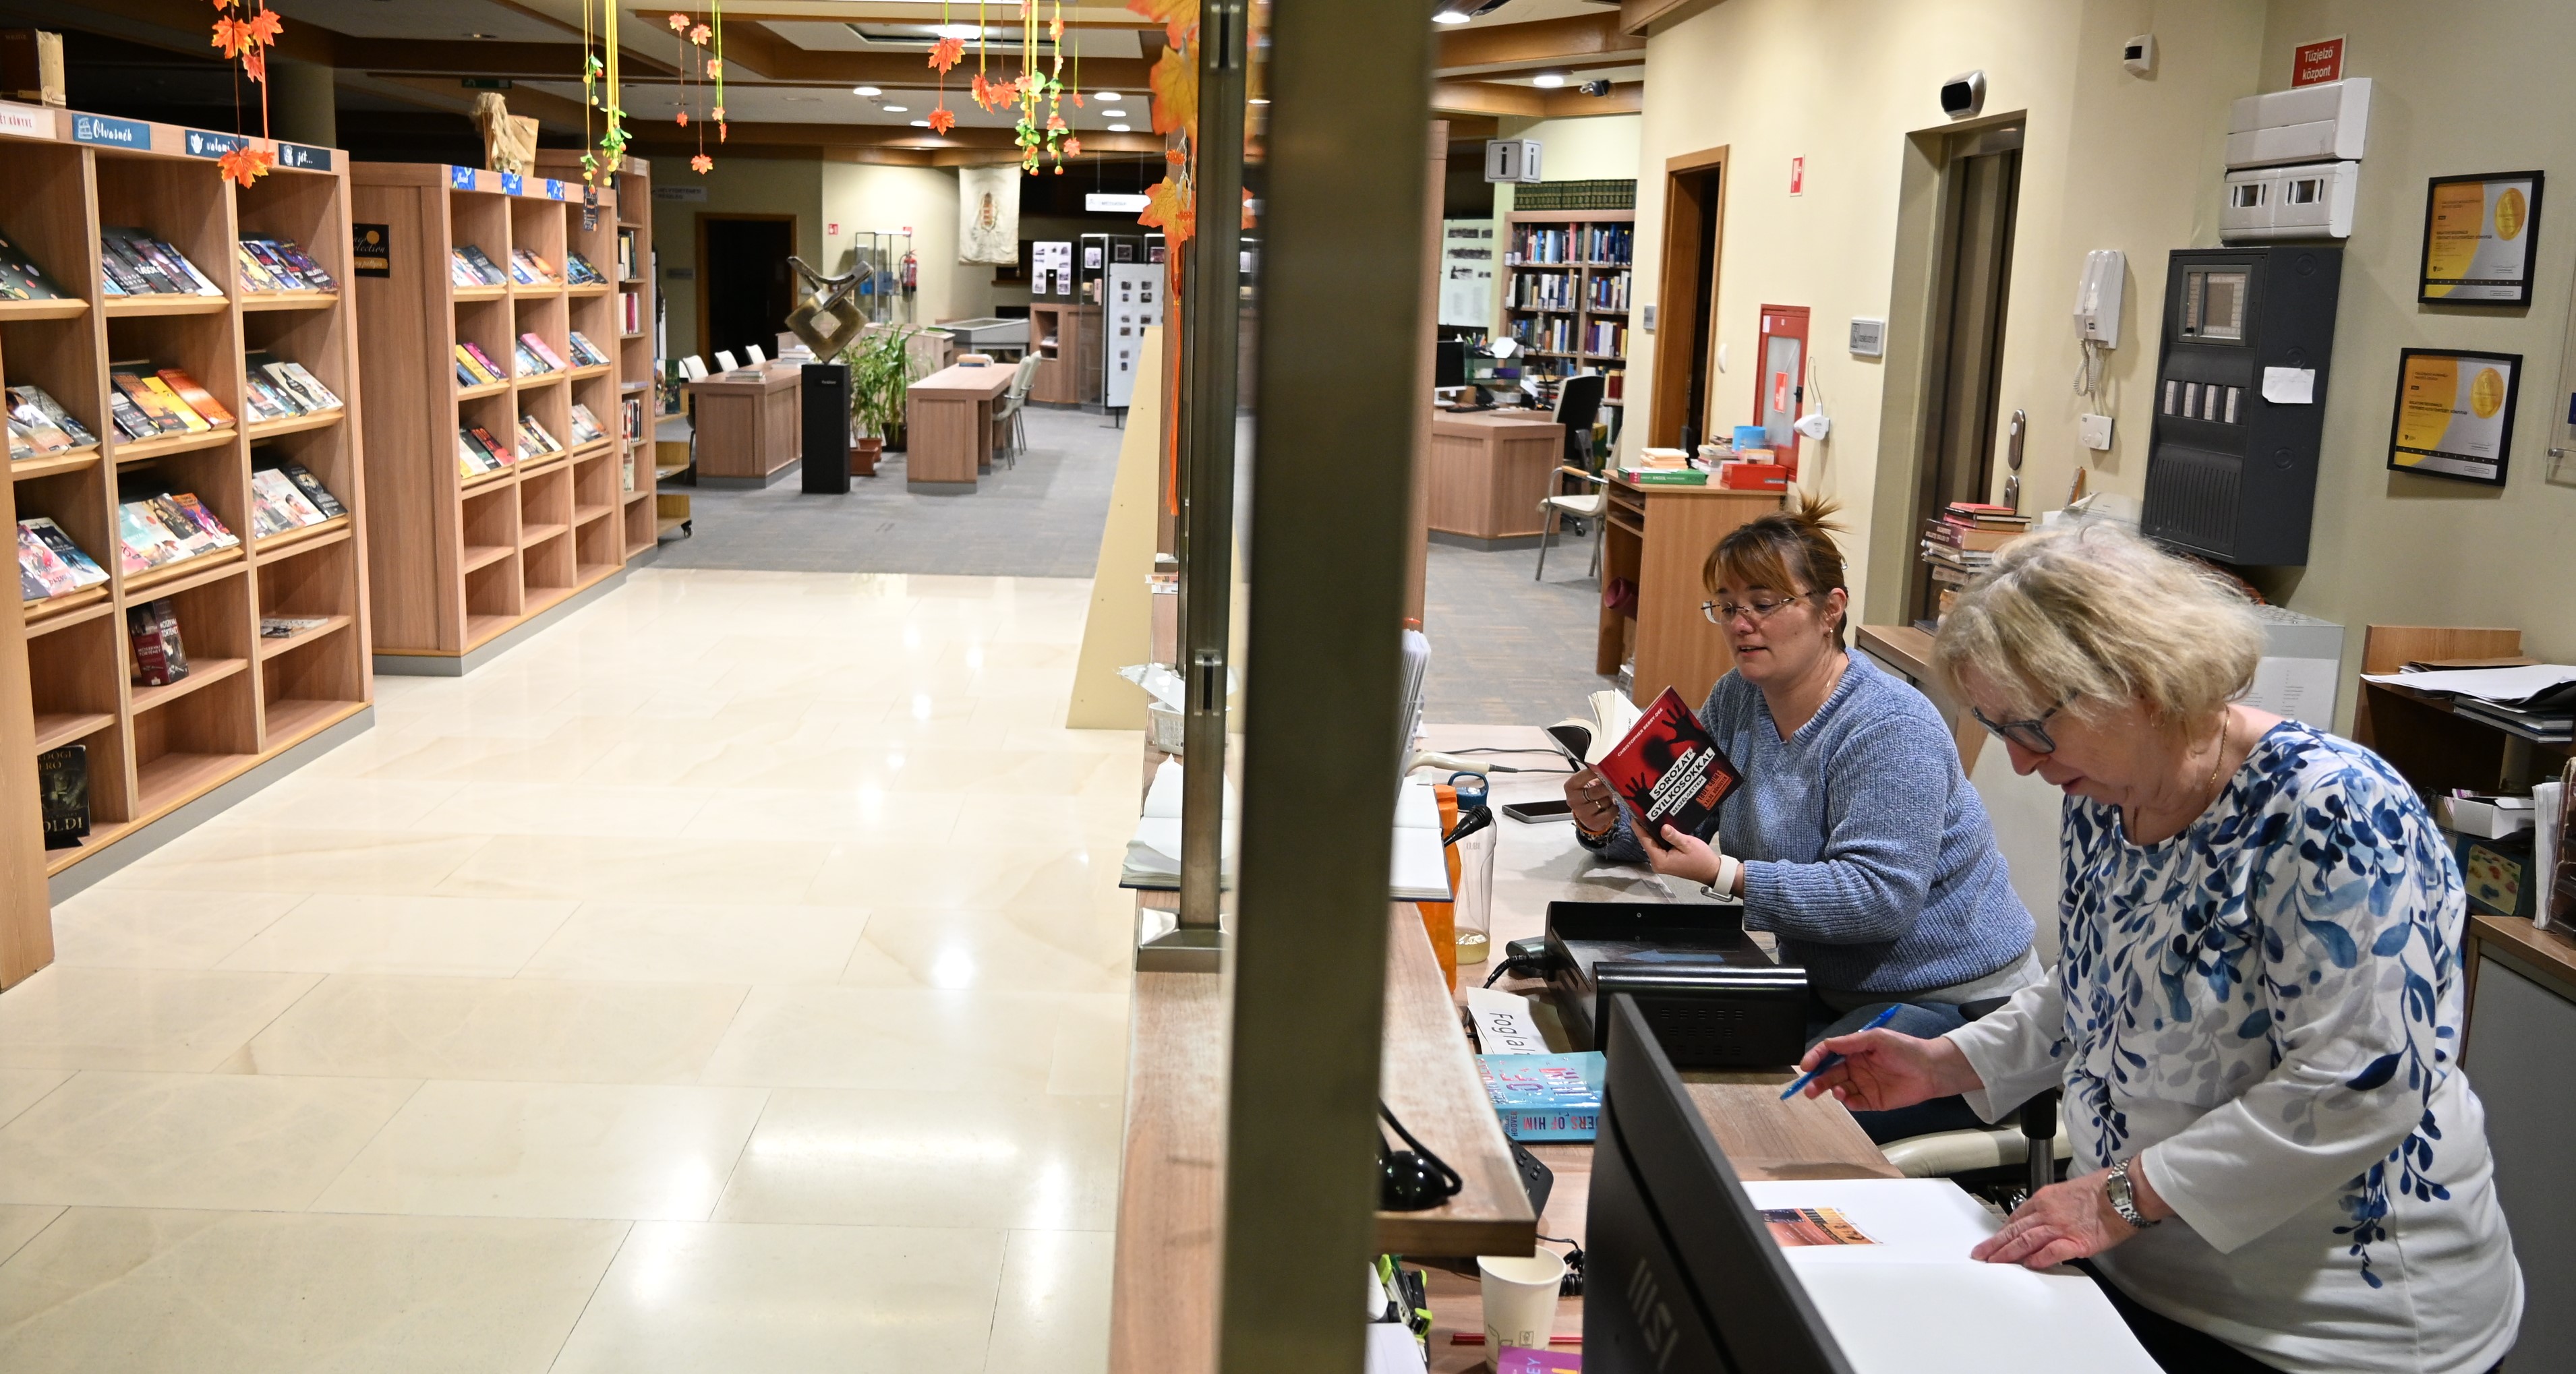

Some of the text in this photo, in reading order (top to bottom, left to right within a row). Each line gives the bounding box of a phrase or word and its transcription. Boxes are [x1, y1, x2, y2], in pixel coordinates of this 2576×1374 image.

[2302, 65, 2331, 82] központ
[92, 119, 133, 142] Olvasnék
[1617, 729, 1644, 757] CHRISTOPHER
[1650, 752, 1714, 818] GYILKOSOKKAL
[1672, 777, 1704, 814] BESZÉLGETTEM
[1523, 1116, 1546, 1131] HIM
[1551, 1116, 1565, 1130] OF
